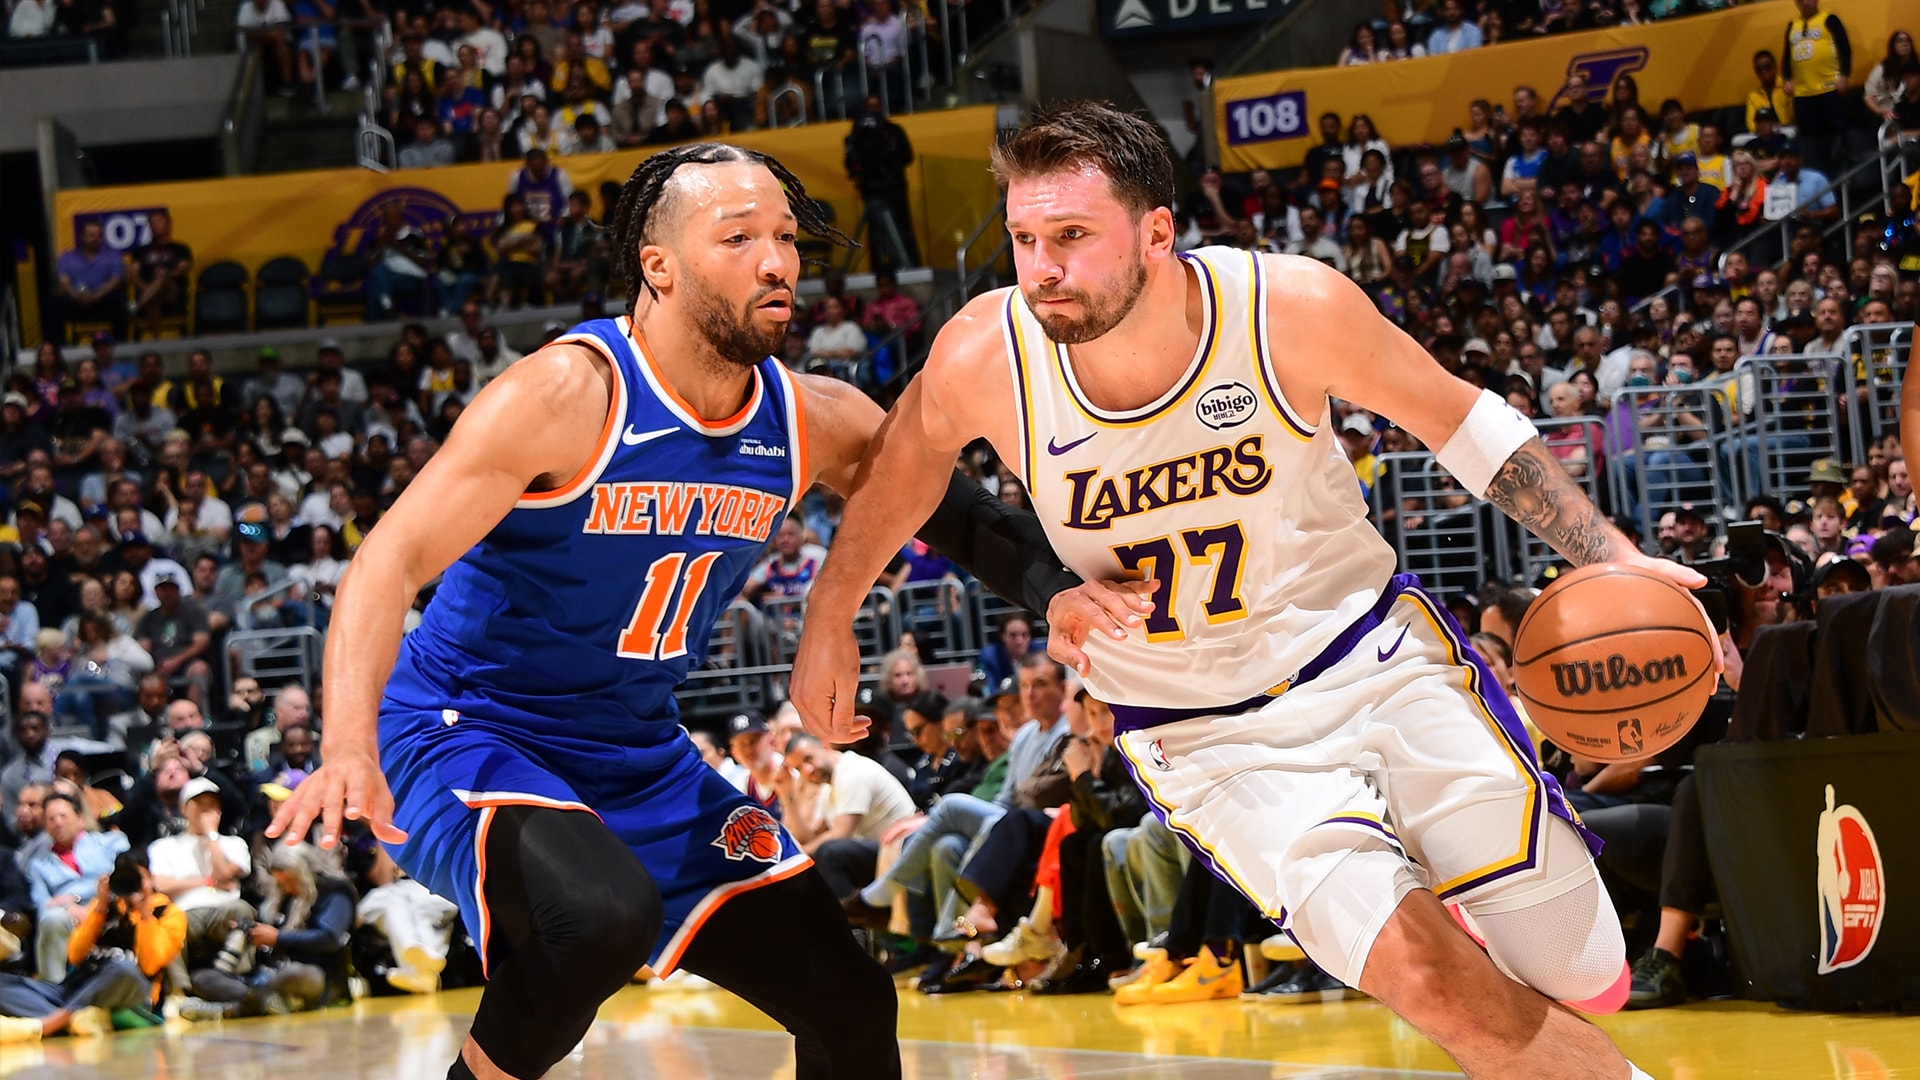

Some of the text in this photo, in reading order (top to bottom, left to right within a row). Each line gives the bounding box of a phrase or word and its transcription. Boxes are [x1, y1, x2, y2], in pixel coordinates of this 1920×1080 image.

[1233, 99, 1300, 138] 108
[105, 214, 153, 249] 07
[1201, 395, 1253, 415] bibigo
[755, 445, 785, 457] dhabi
[1061, 434, 1274, 532] LAKERS
[583, 482, 786, 542] NEW YORK
[1108, 519, 1249, 643] 77
[617, 552, 723, 660] 11
[1551, 654, 1687, 696] Wilson
[1858, 868, 1878, 900] NBA
